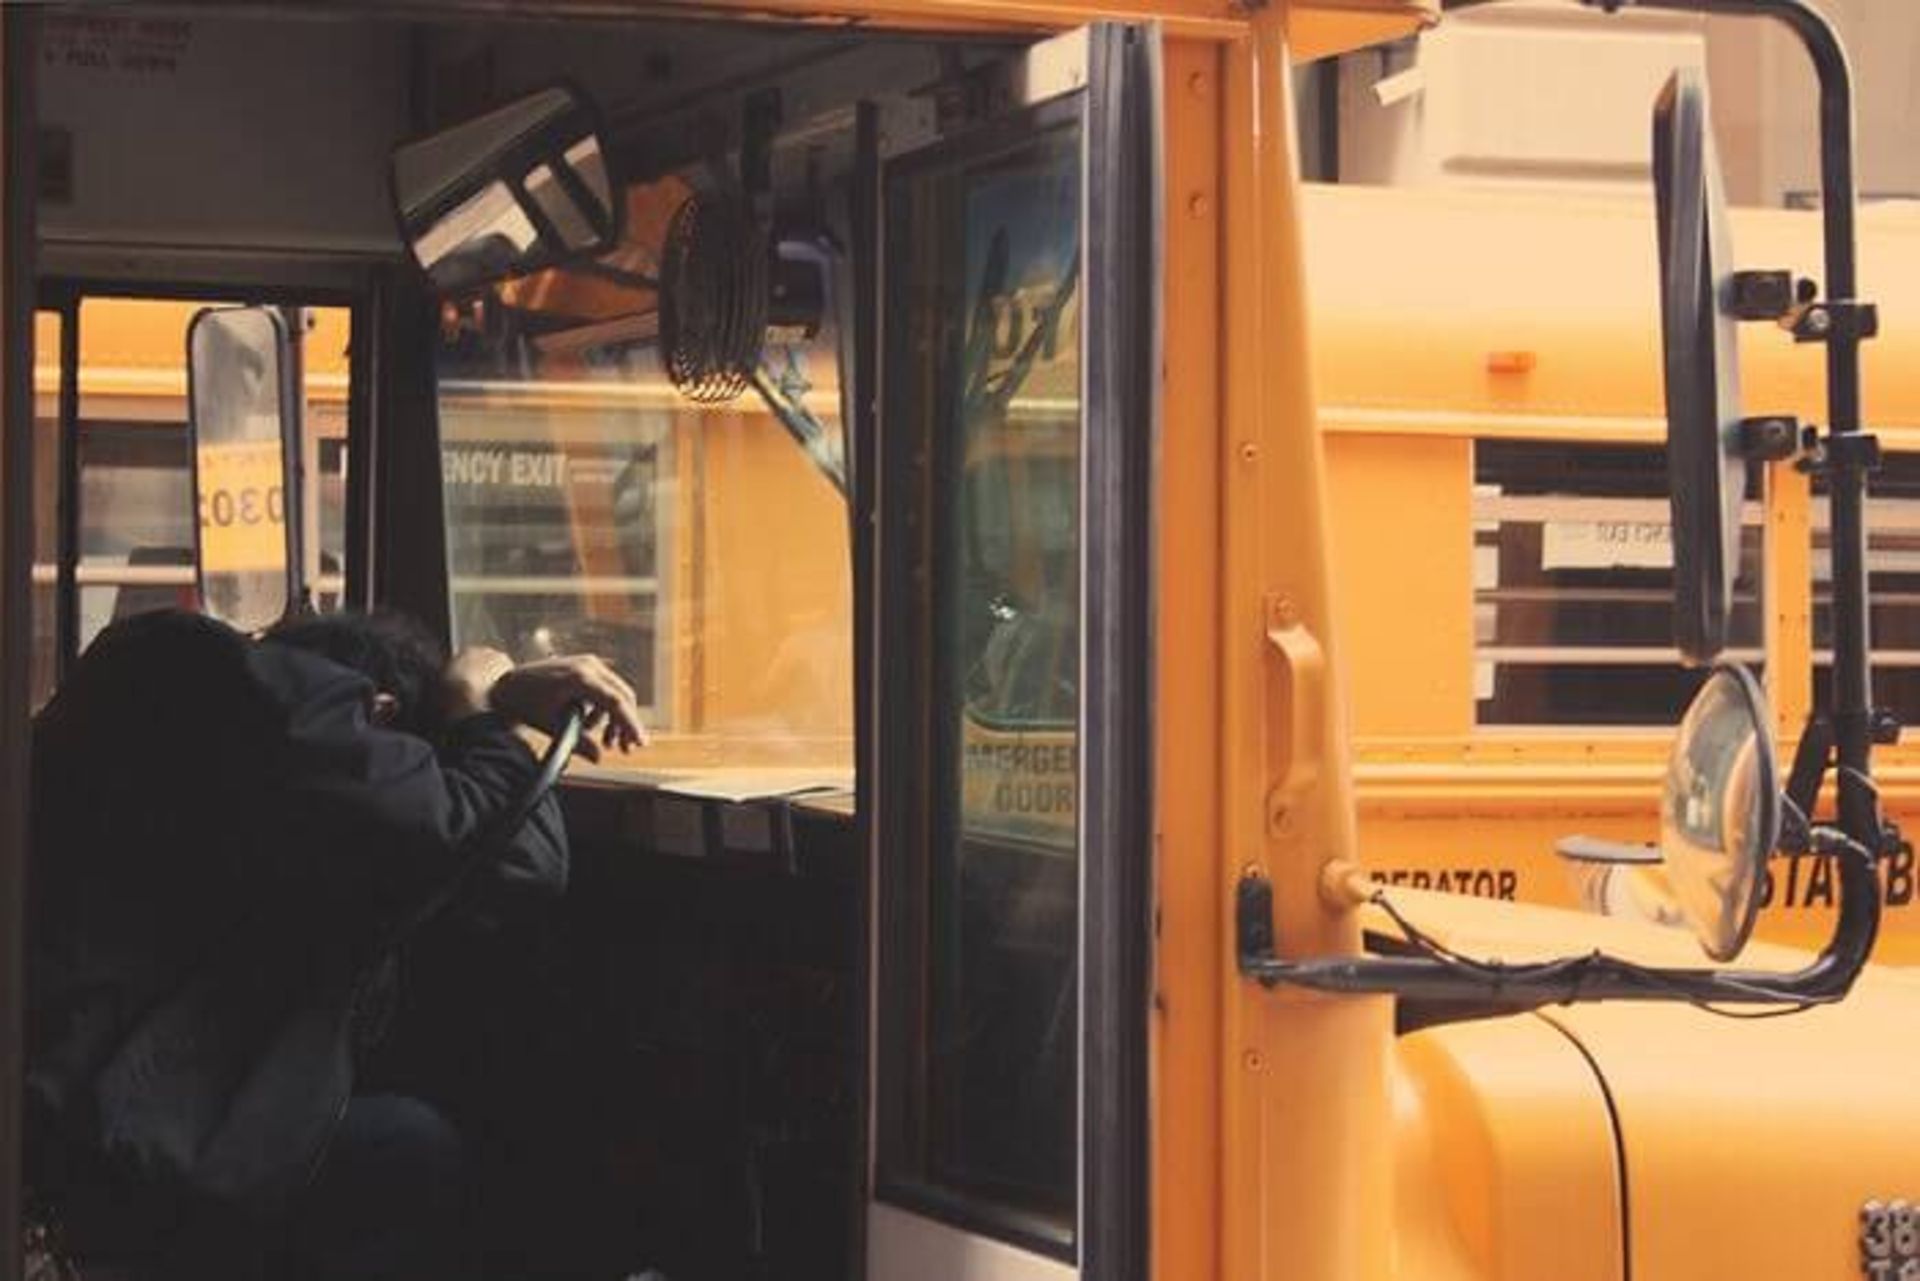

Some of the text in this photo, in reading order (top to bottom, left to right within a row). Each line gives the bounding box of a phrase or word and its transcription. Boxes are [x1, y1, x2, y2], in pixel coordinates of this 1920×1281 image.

[512, 453, 567, 486] EXIT
[965, 744, 1076, 774] MERGE
[1887, 842, 1920, 907] B
